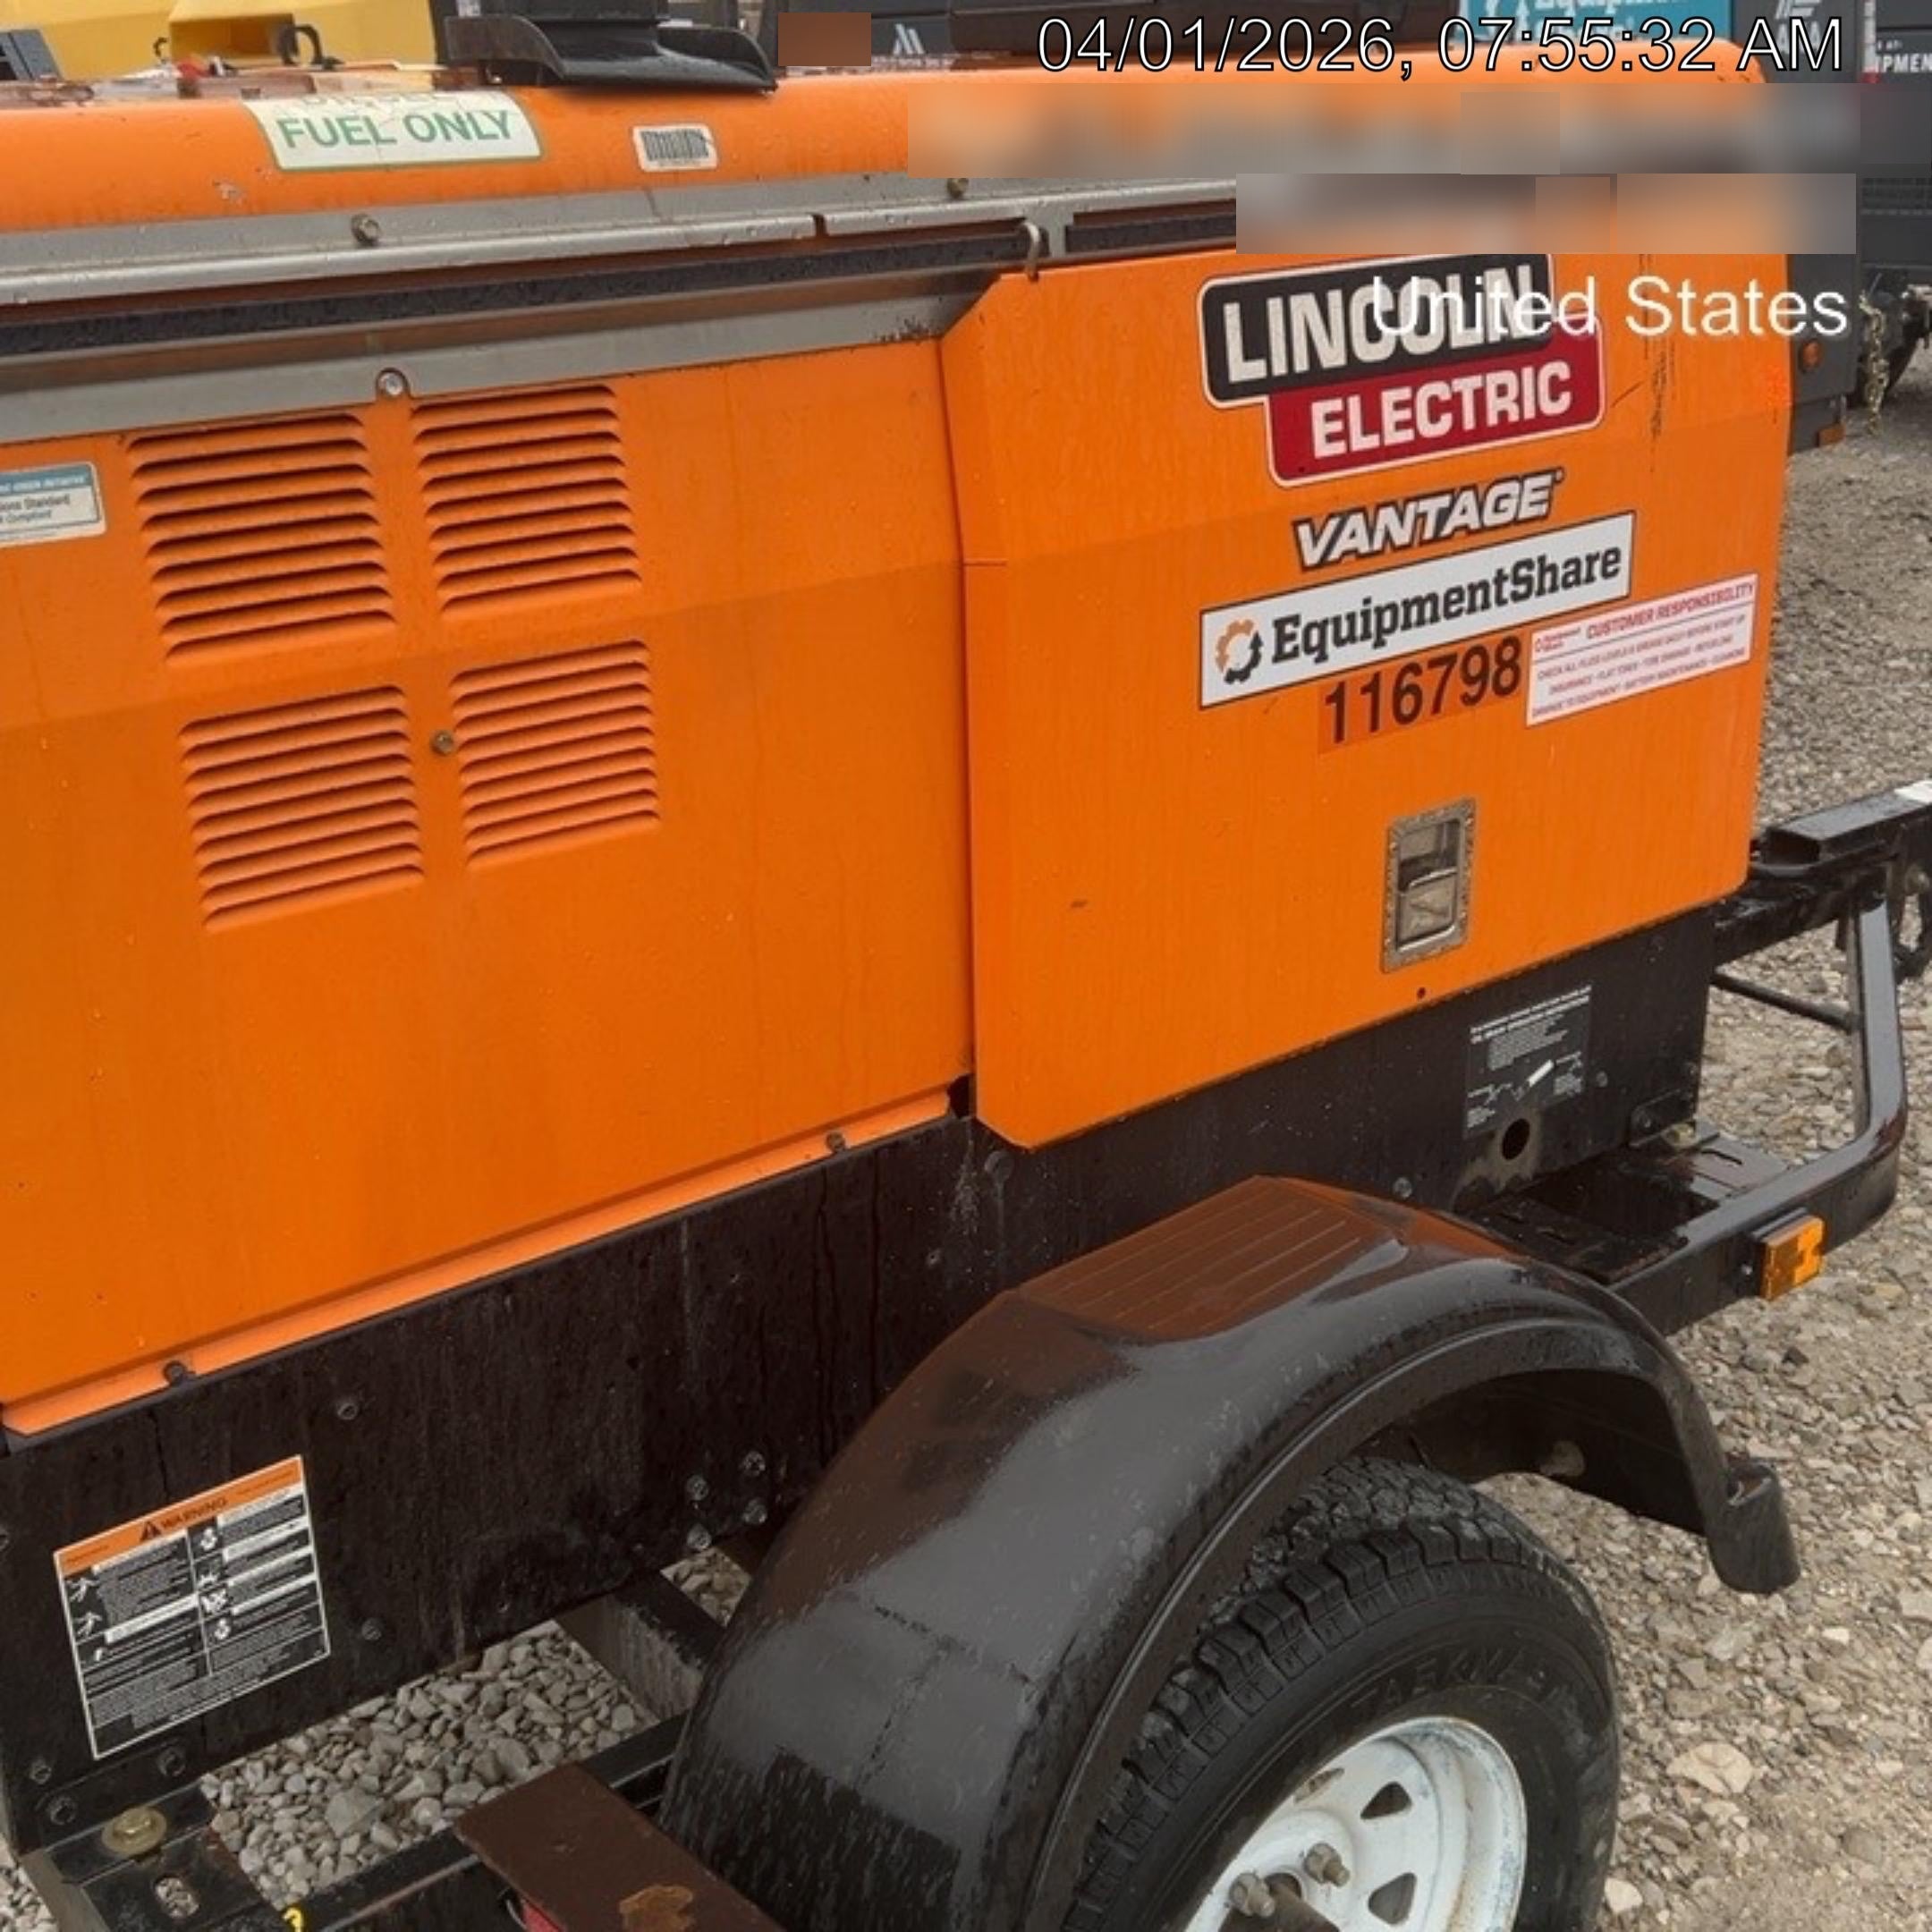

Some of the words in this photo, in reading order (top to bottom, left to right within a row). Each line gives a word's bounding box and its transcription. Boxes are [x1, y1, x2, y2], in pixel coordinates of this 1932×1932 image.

[276, 114, 398, 148] FUEL
[404, 109, 514, 144] ONLY
[1223, 265, 1537, 384] LINCOLN
[1310, 360, 1572, 460] ELECTRIC
[1294, 473, 1555, 568] VANTAGE
[1270, 546, 1623, 664] EquipmentShare
[1587, 608, 1654, 640] CUSTOMER
[1657, 582, 1753, 619] RESPONSIBILITY
[1324, 636, 1521, 744] 116798
